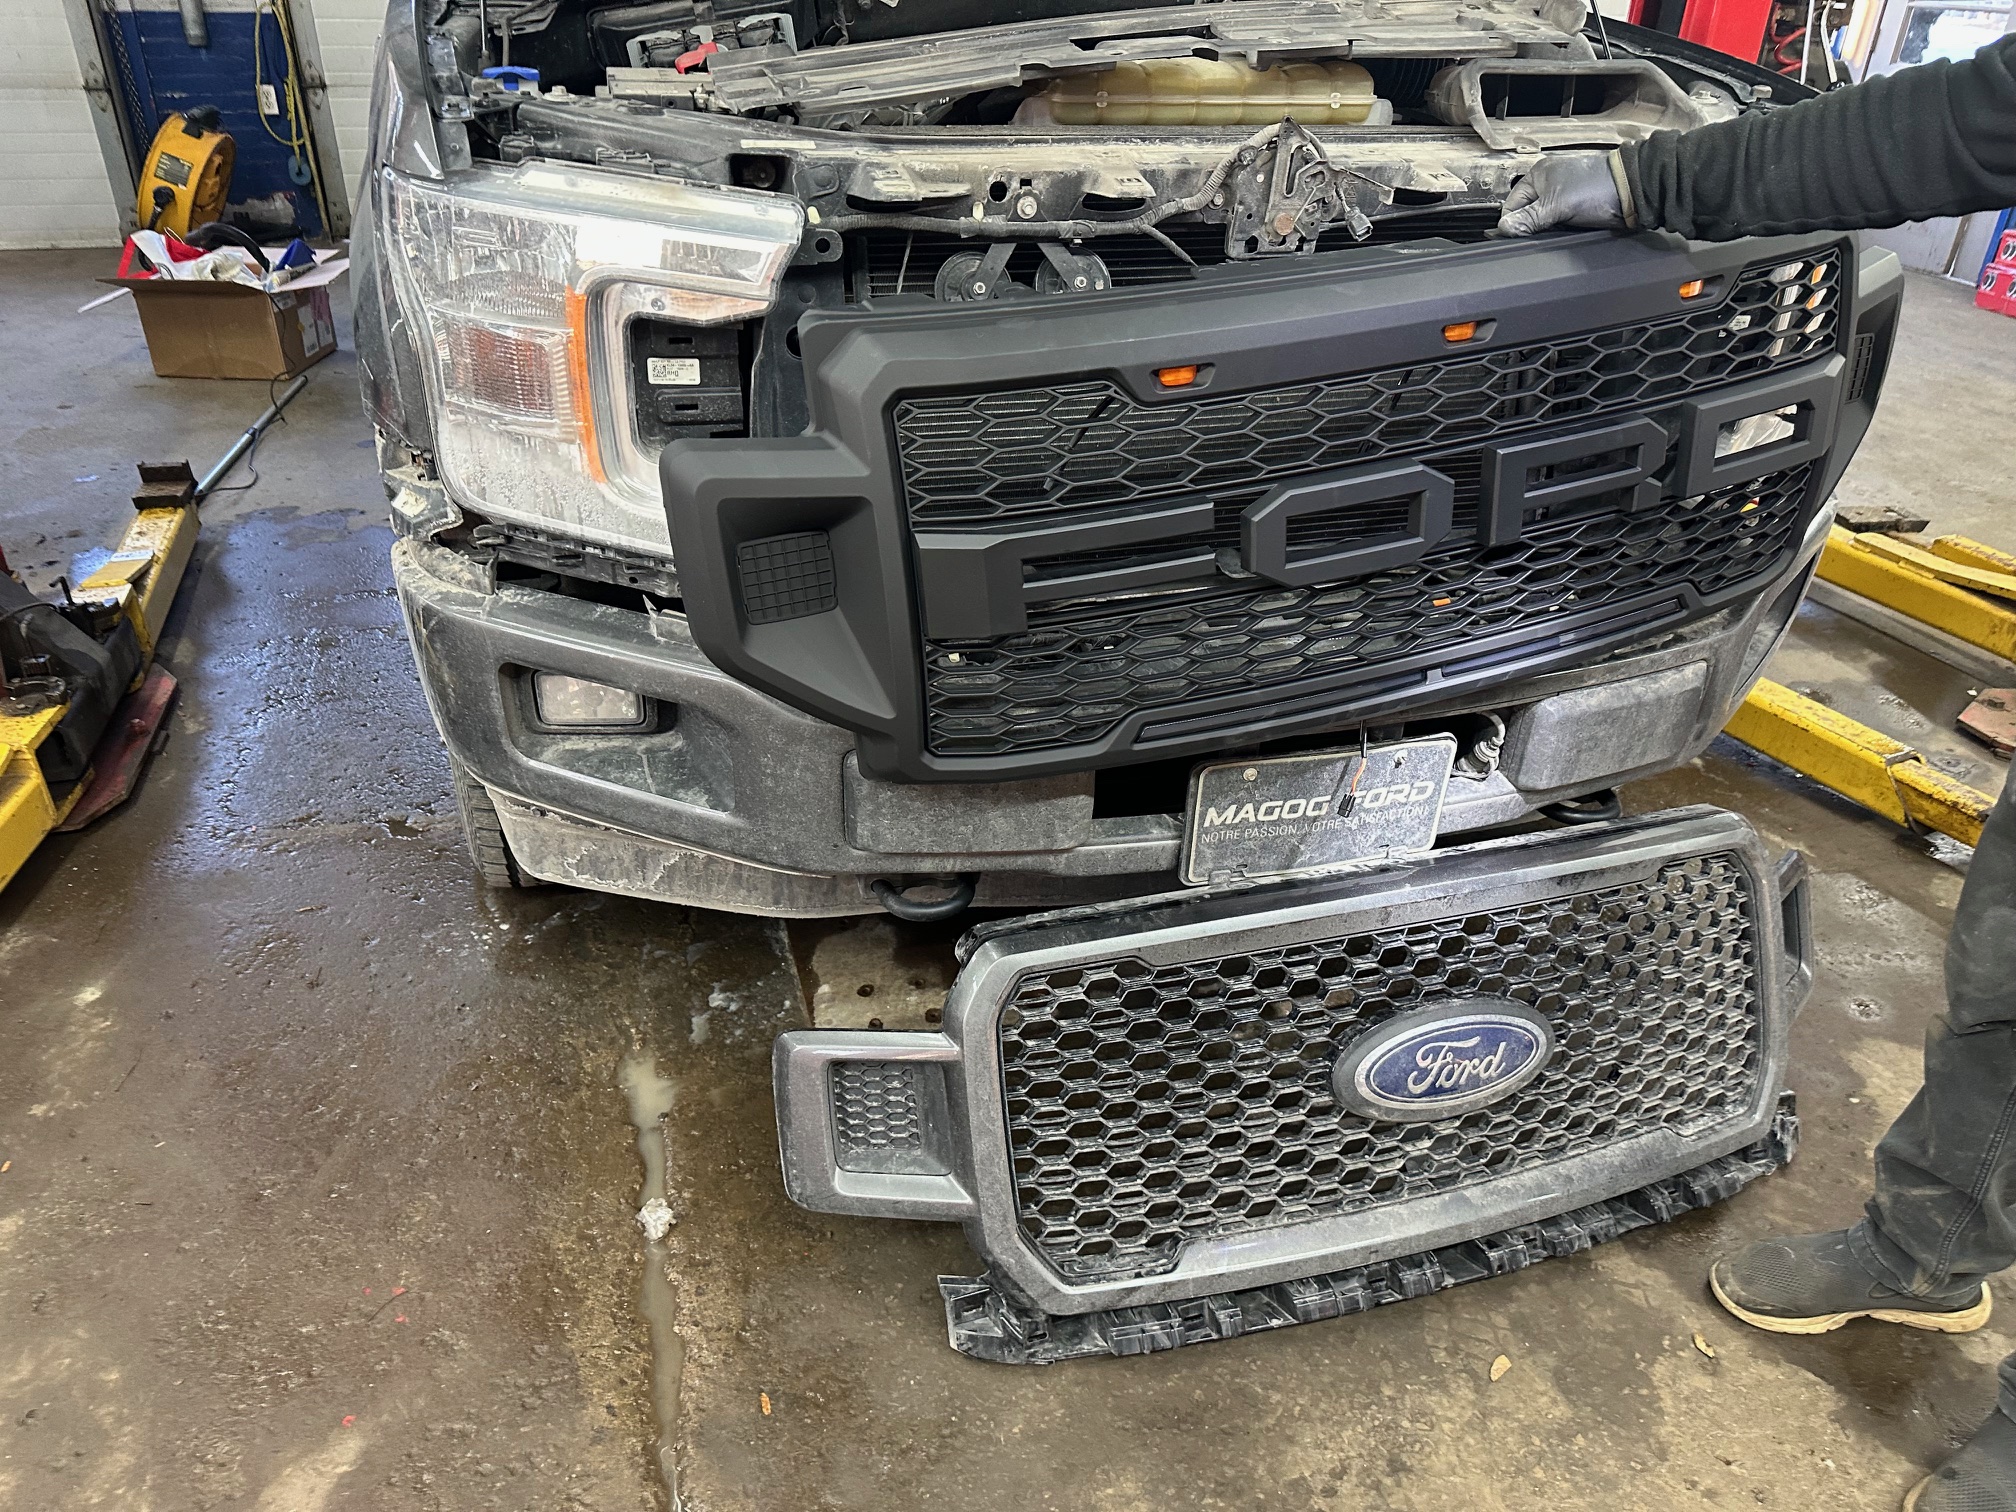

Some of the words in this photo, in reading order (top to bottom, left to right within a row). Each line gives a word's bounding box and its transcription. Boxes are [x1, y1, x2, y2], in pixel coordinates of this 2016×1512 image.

[914, 352, 1846, 640] FORD
[1203, 794, 1332, 828] MAGOG
[1353, 780, 1436, 809] FORD
[1201, 829, 1241, 844] NOTRE
[1304, 819, 1342, 834] VOTRE
[1407, 1035, 1507, 1095] Ford
